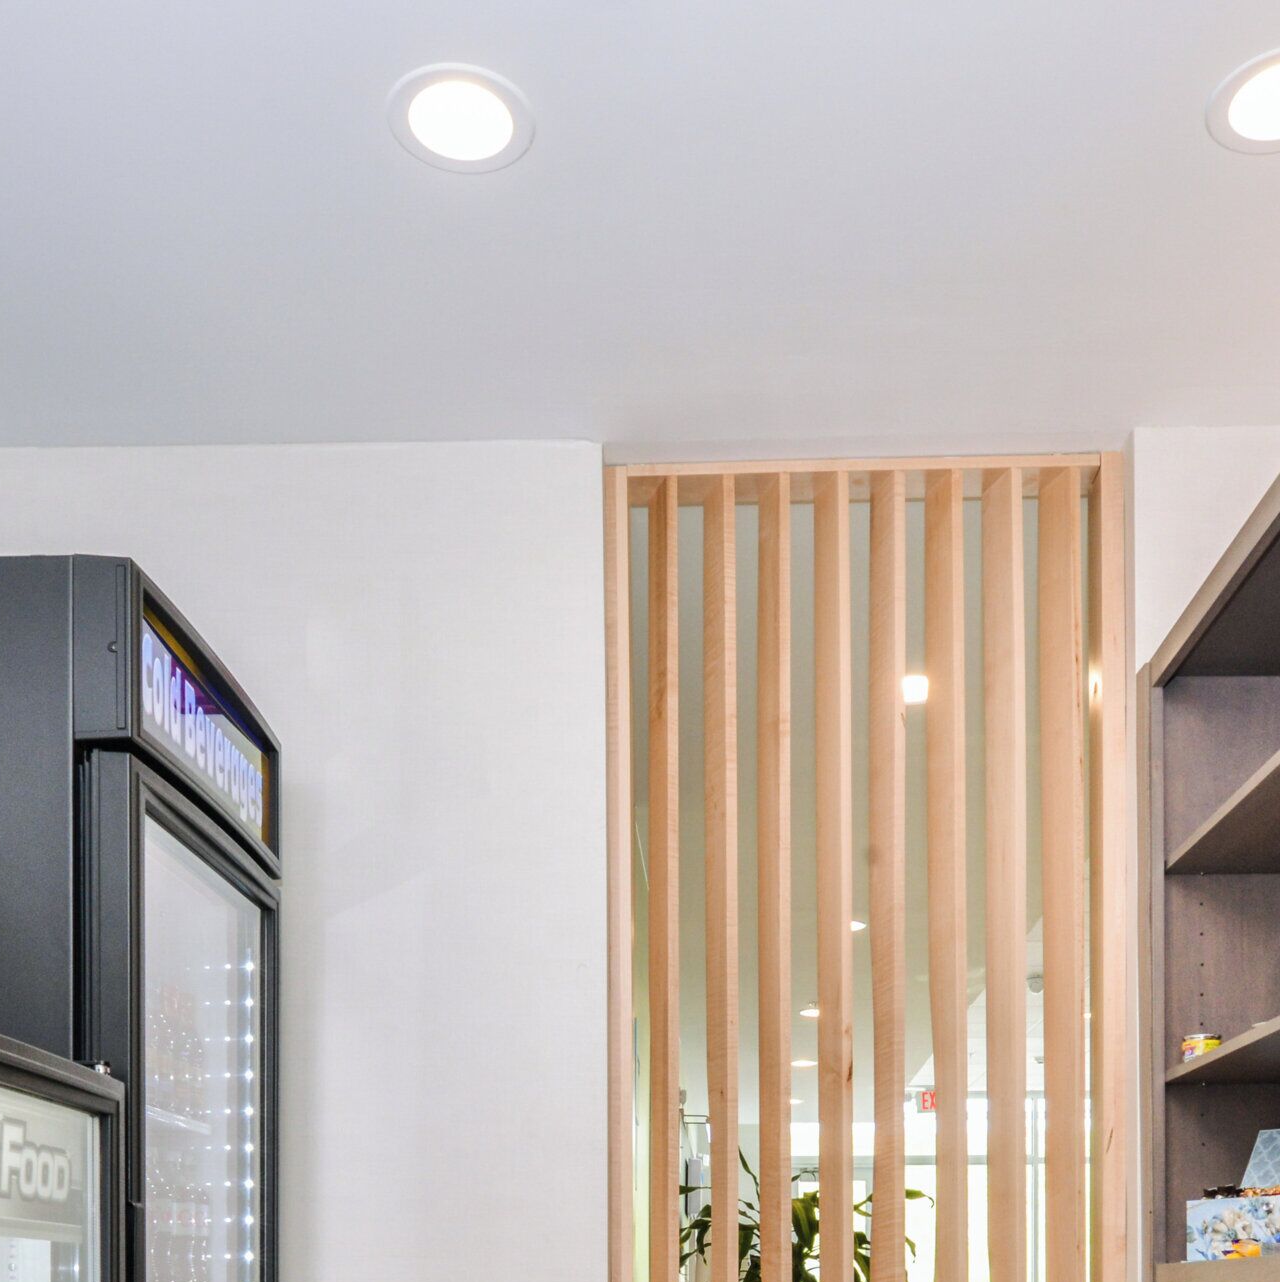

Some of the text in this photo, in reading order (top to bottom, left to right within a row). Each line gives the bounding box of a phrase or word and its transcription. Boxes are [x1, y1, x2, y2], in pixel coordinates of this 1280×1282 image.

[142, 633, 264, 829] Cold Beverages
[921, 1091, 937, 1110] EX
